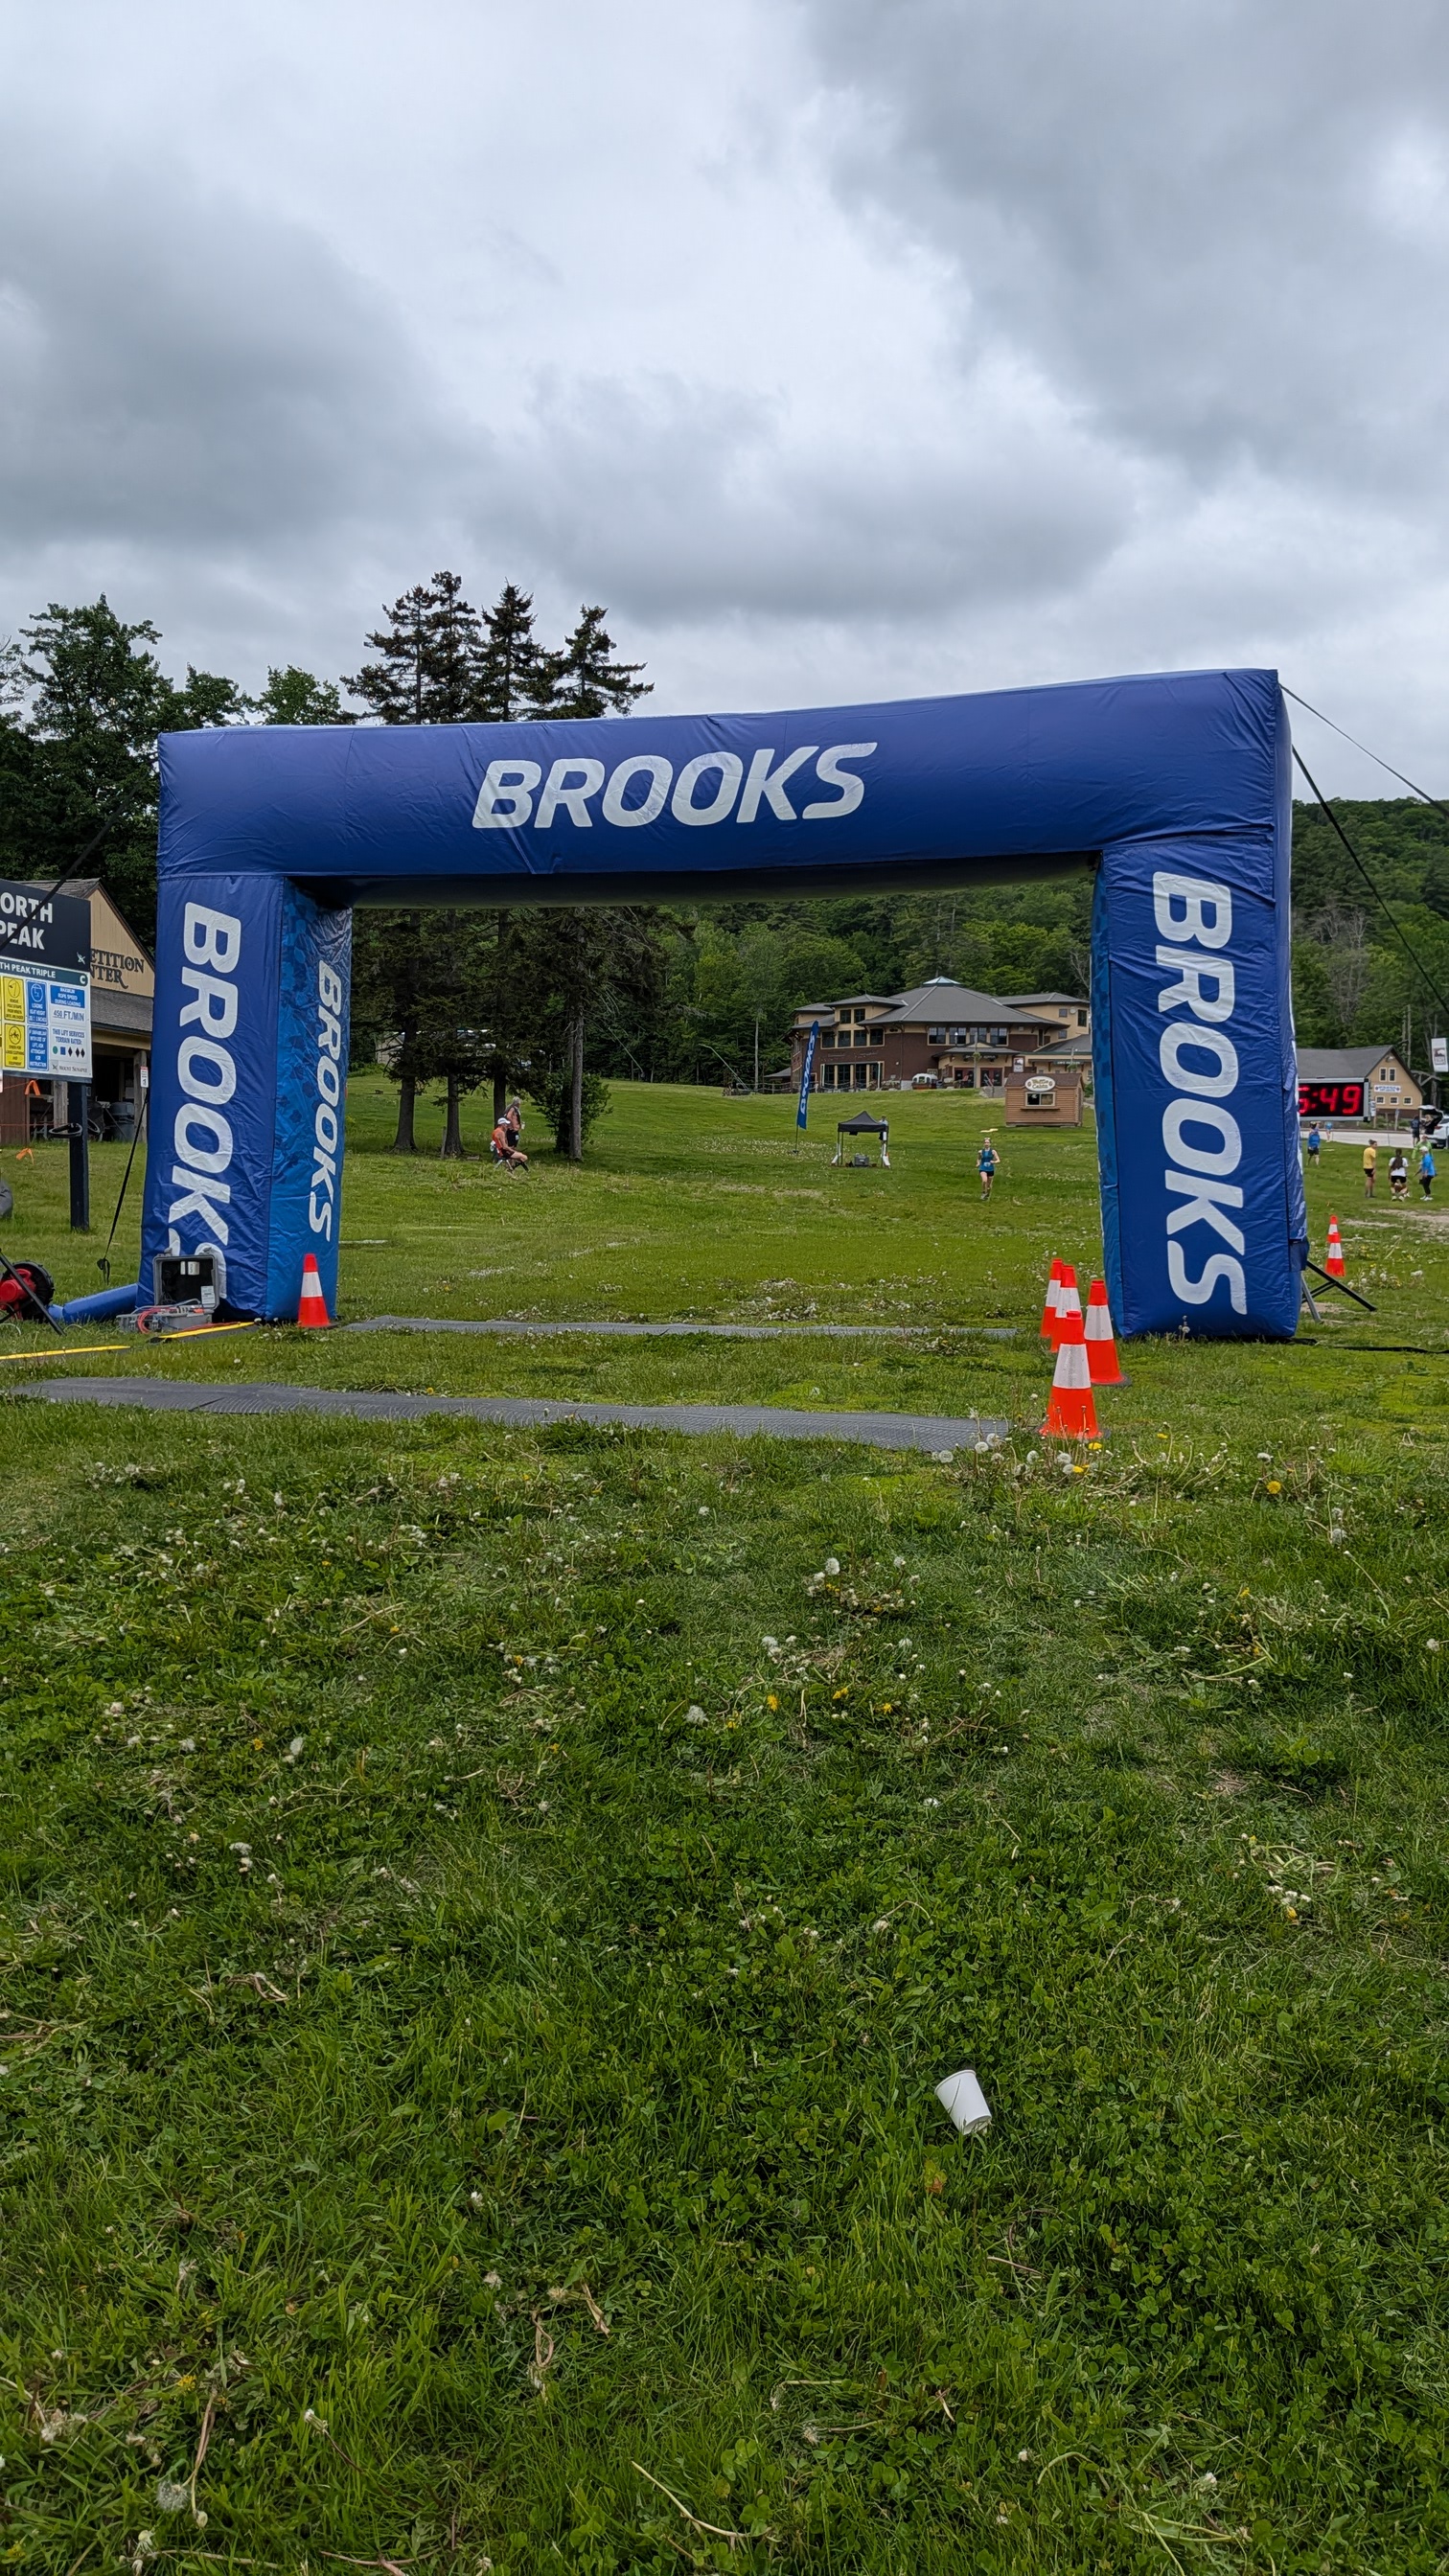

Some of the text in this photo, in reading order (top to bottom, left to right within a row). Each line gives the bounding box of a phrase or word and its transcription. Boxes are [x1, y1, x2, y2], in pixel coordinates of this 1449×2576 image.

[472, 742, 878, 828] BROOKS
[12, 964, 31, 975] PEAK
[31, 968, 56, 978] TRIPLE
[80, 975, 86, 984] C
[310, 959, 342, 1242] BROOKS
[1152, 871, 1247, 1315] BROOKS
